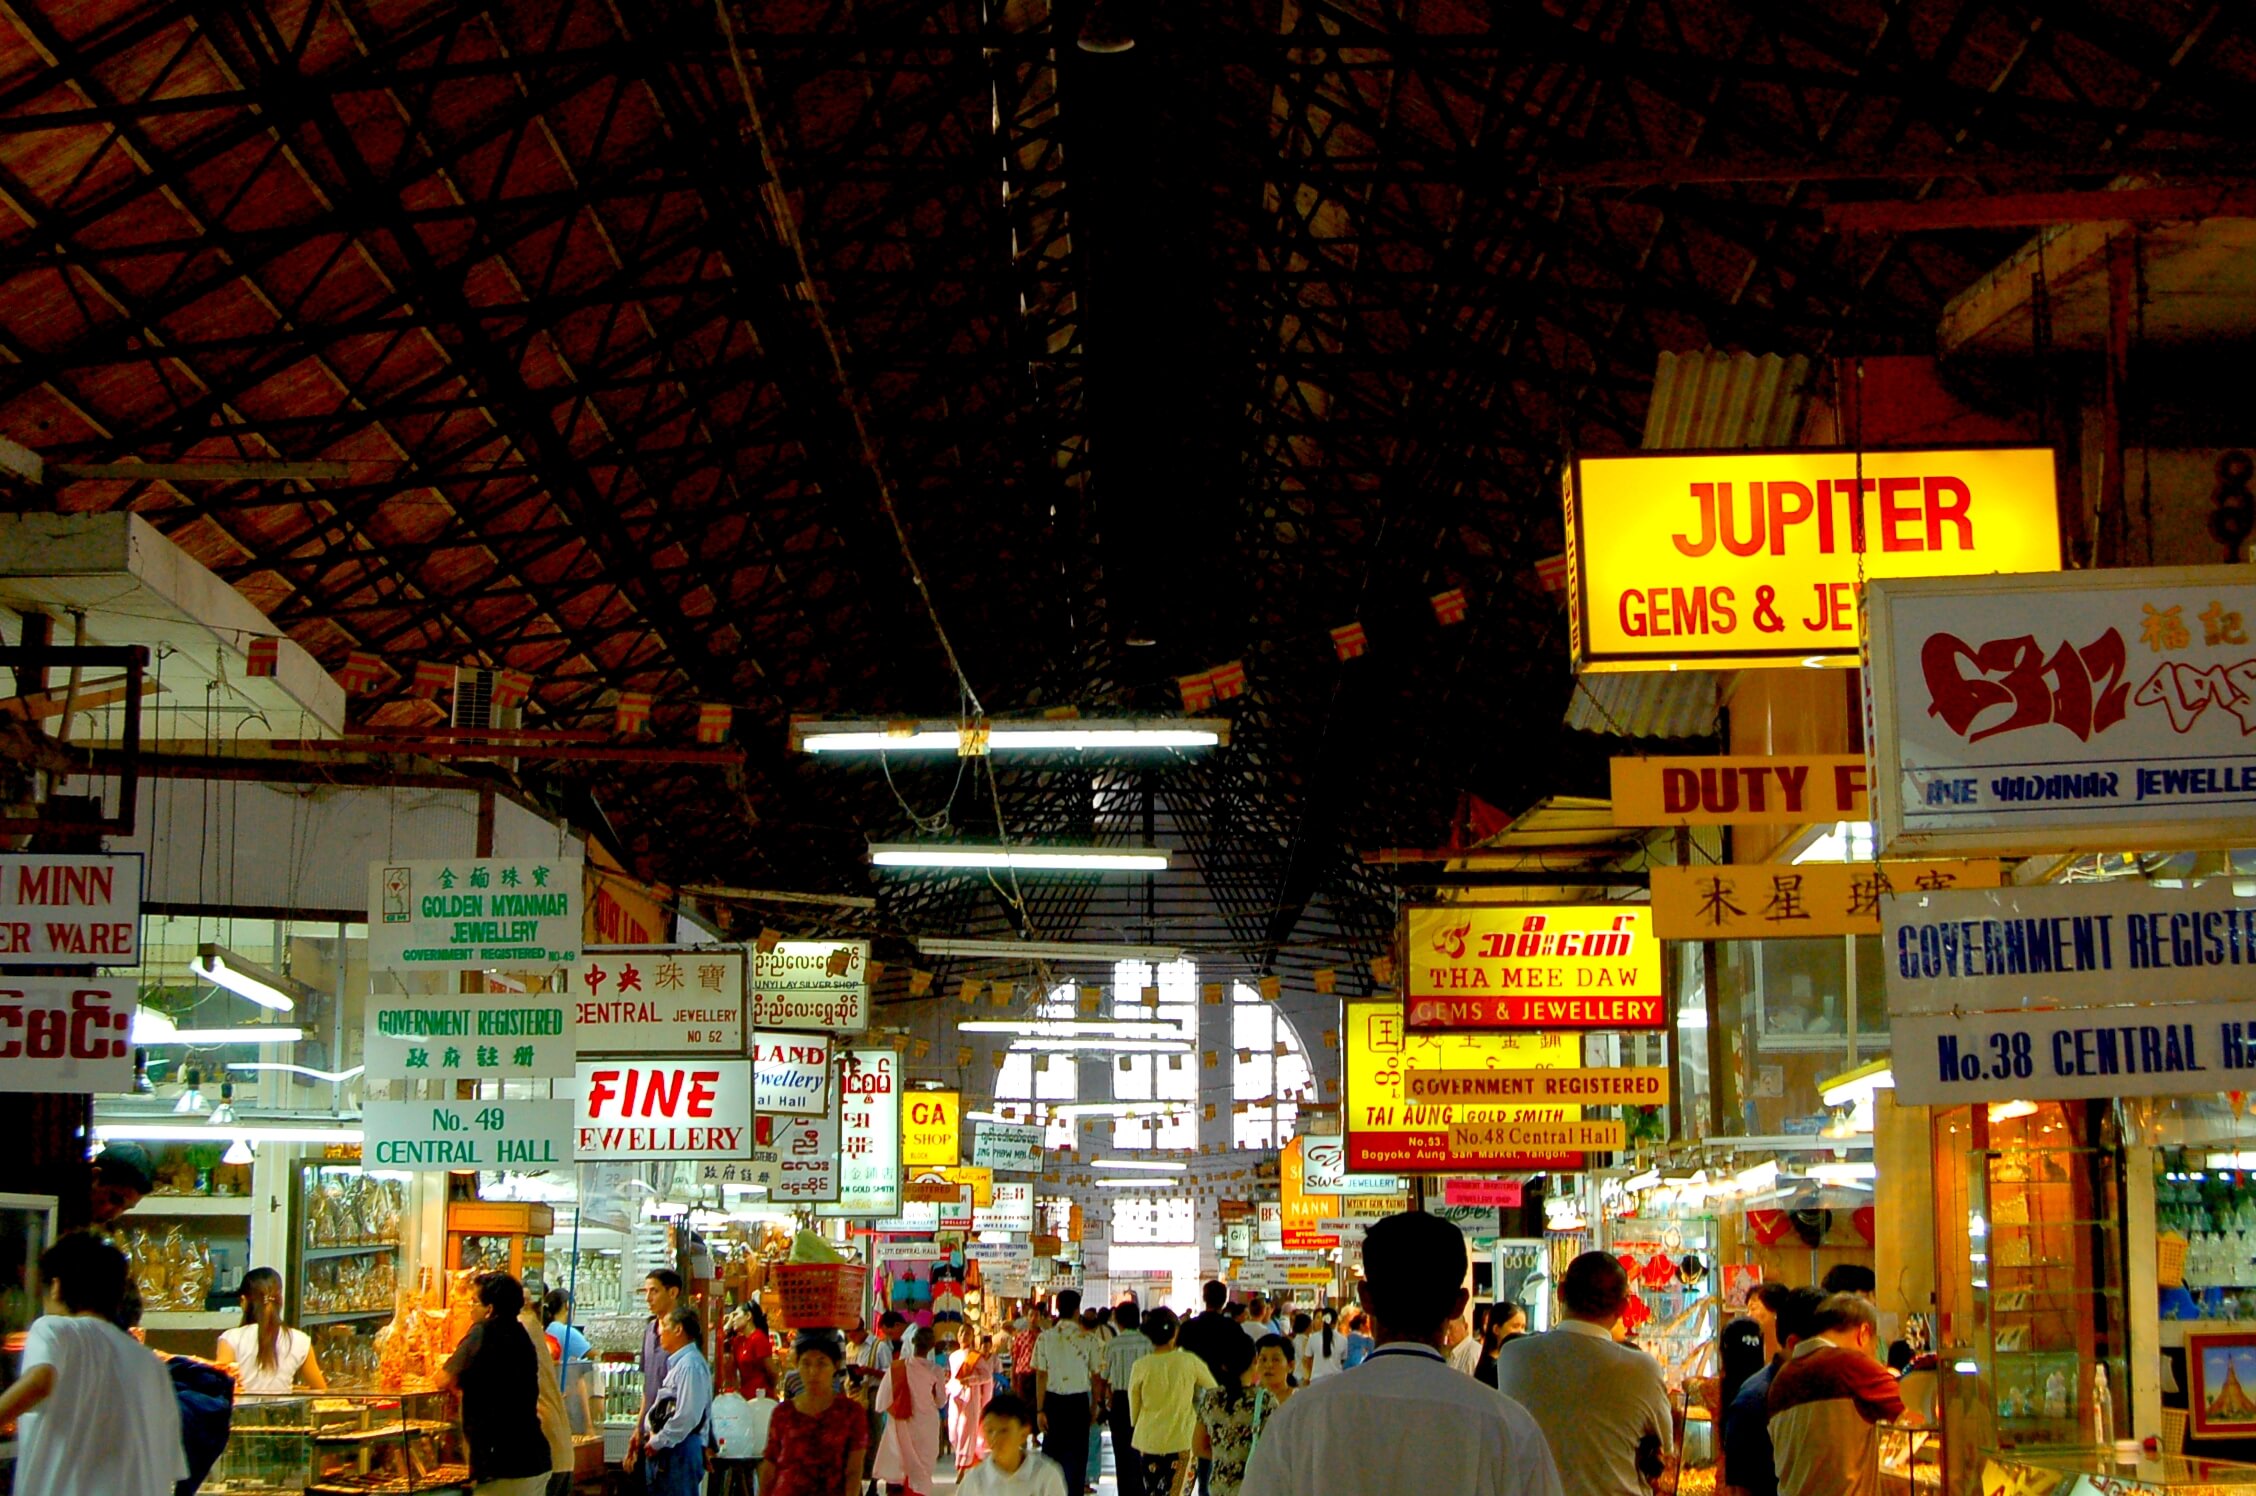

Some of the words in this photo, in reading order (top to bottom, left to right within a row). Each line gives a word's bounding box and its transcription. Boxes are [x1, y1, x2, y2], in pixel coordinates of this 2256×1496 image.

[1672, 476, 1974, 557] JUPITER
[1619, 586, 1737, 637] GEMS
[1753, 584, 1785, 633] &
[2139, 600, 2248, 653] 福記
[1663, 767, 1809, 814] DUTY
[1926, 778, 1977, 806] AYE
[1992, 772, 2119, 802] YADANAR
[17, 864, 114, 907] MINN
[422, 895, 483, 918] GOLDEN
[491, 893, 568, 918] MYANMAR
[46, 923, 133, 954] WARE
[450, 920, 538, 944] JEWELLERY
[402, 948, 474, 961] GOVERNMENT
[480, 947, 546, 961] REGISTERED
[1897, 914, 2113, 980] GOVERNMENT
[1430, 968, 1491, 988] THA
[1501, 968, 1562, 988] MEE
[1577, 967, 1638, 988] DAW
[378, 1009, 471, 1036] GOVERNMENT
[477, 1008, 563, 1036] REGISTERED
[672, 1008, 738, 1024] JEWELLERY
[1417, 1001, 1482, 1021] GEMS
[1496, 1001, 1510, 1021] &
[1522, 1001, 1656, 1021] JEWELLERY
[687, 1030, 702, 1043] NO
[708, 1030, 722, 1043] 52
[1938, 1031, 2034, 1083] No.38
[2052, 1023, 2207, 1076] CENTRAL
[588, 1068, 720, 1119] FINE
[1412, 1078, 1534, 1096] GOVERNMENT
[1546, 1077, 1659, 1094] REGISTERED
[779, 1096, 806, 1108] Hall
[433, 1108, 469, 1132] No.
[474, 1107, 505, 1132] 49
[1366, 1106, 1394, 1126] TAI
[1403, 1105, 1453, 1126] AUNG
[1467, 1109, 1506, 1123] GOLD
[1513, 1109, 1564, 1123] SMITH
[914, 1133, 952, 1146] SHOP
[1456, 1128, 1504, 1145] No.48
[1509, 1128, 1573, 1145] Central
[1580, 1127, 1618, 1144] Hall
[376, 1140, 482, 1164] CENTRAL
[497, 1139, 559, 1163] HALL
[1361, 1149, 1411, 1161] Bogyoke
[1416, 1149, 1446, 1160] Aung
[1347, 1178, 1395, 1188] JEWELLERY
[1291, 1200, 1329, 1216] NANN
